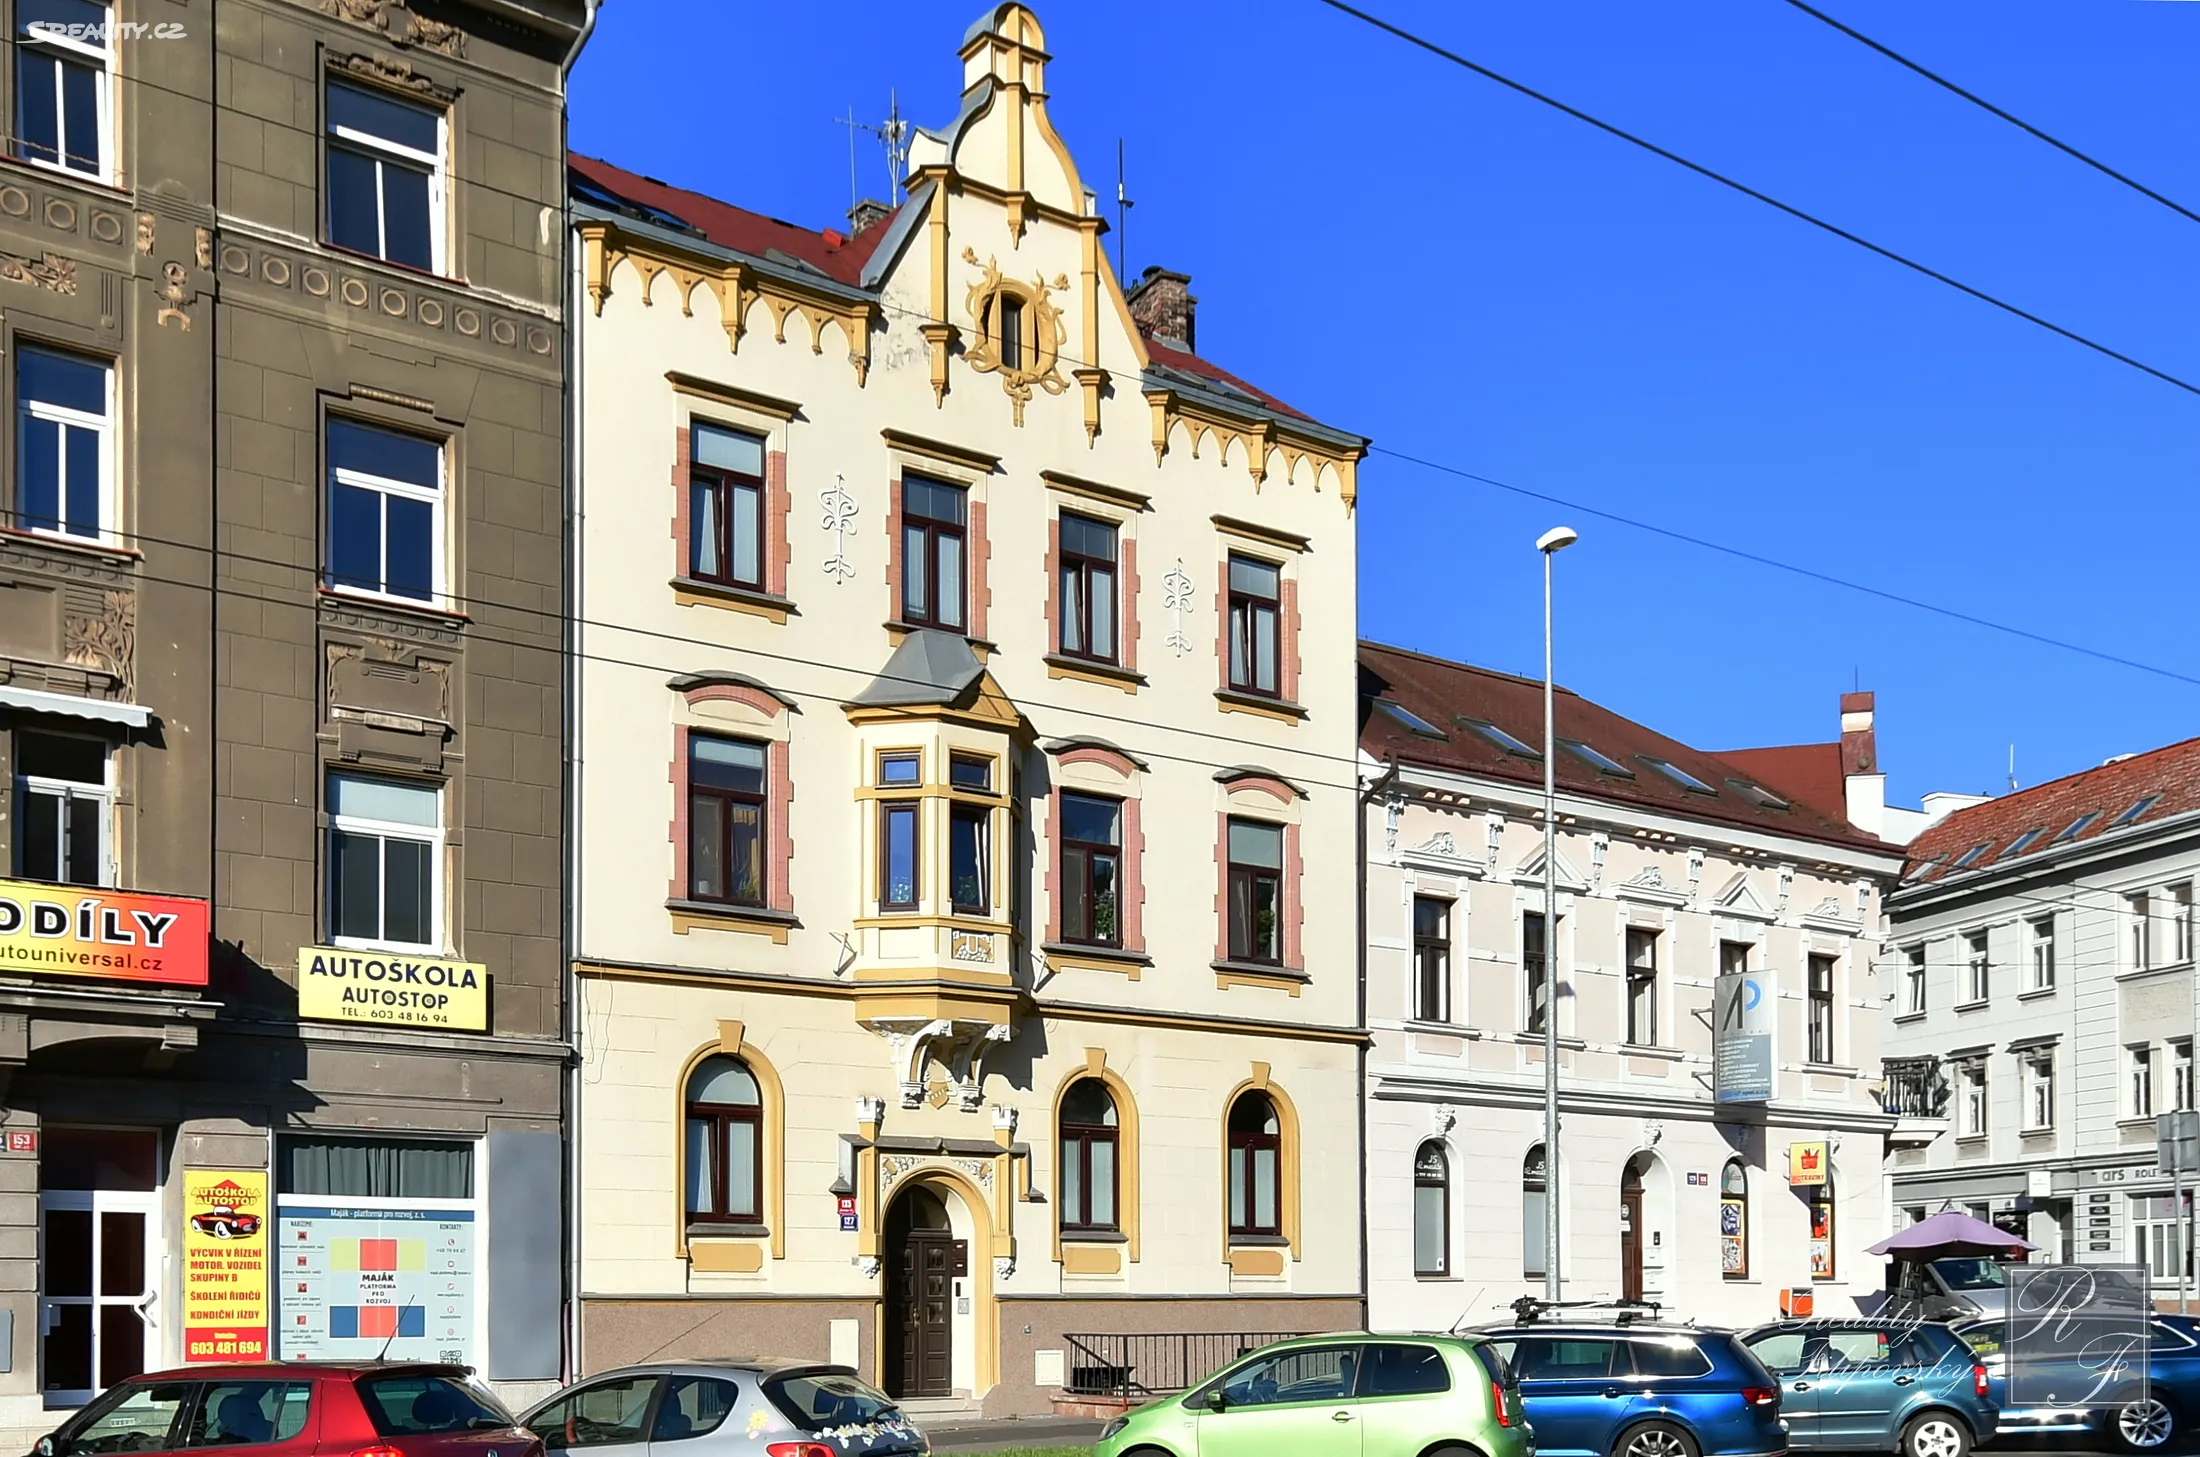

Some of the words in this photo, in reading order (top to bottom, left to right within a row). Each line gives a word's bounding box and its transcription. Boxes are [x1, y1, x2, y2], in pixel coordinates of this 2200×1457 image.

[309, 955, 478, 990] AUTOŠKOLA
[342, 986, 449, 1010] AUTOSTOP
[370, 1009, 394, 1020] 603
[433, 1014, 448, 1024] 94
[13, 1134, 30, 1145] 153
[190, 1185, 262, 1198] AUTOŠKOLA
[194, 1196, 258, 1206] AUTOSTOP
[190, 1247, 224, 1258] VÝCVIK
[225, 1248, 232, 1258] V
[233, 1246, 262, 1258] ŘÍZENÍ
[190, 1261, 225, 1270] MOTOR.
[227, 1261, 262, 1270] VOZIDEL
[190, 1273, 229, 1282] SKUPINY
[231, 1273, 238, 1282] B
[361, 1272, 394, 1282] MAJÁK
[190, 1290, 227, 1301] ŠKOLENÍ
[229, 1289, 261, 1301] ŘIDIČŮ
[190, 1309, 234, 1320] KONDIČNÍ
[237, 1310, 260, 1319] JÍZDY
[190, 1341, 214, 1355] 603
[216, 1341, 237, 1354] 481
[239, 1341, 262, 1354] 694
